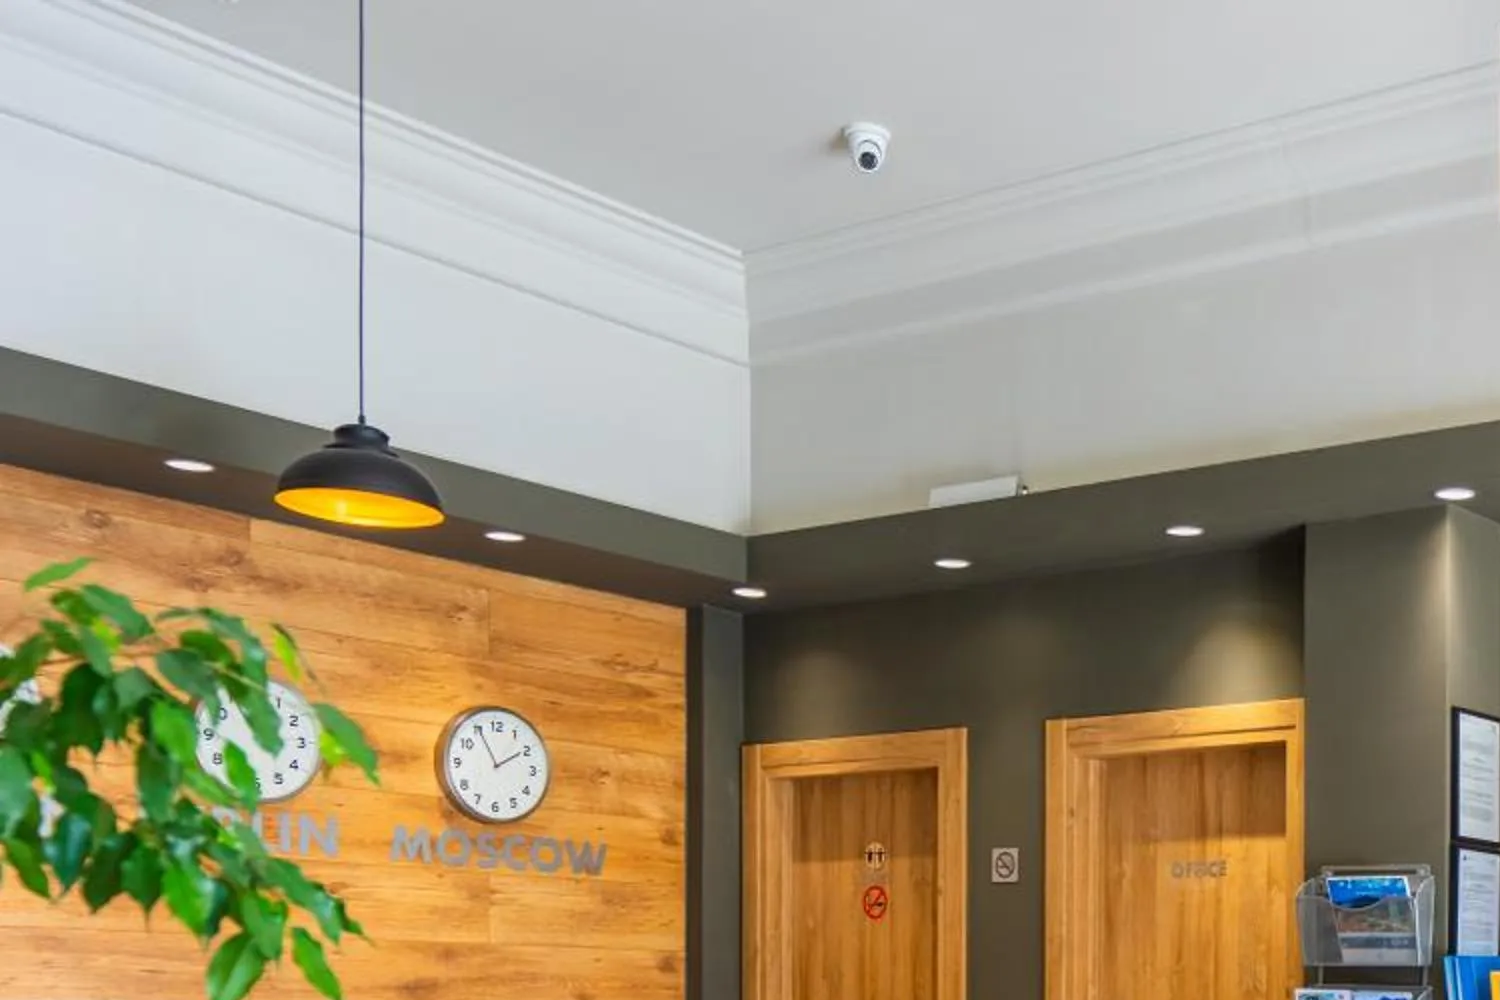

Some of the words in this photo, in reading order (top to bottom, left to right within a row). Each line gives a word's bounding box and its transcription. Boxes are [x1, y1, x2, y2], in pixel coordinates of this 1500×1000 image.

[289, 715, 299, 728] 2
[490, 719, 504, 733] 12
[203, 728, 215, 741] 9
[511, 729, 517, 740] 1
[297, 737, 306, 749] 3
[460, 737, 475, 751] 10
[523, 745, 531, 757] 2
[289, 758, 299, 770] 4
[453, 757, 462, 769] 9
[529, 765, 537, 777] 3
[273, 772, 283, 785] 5
[460, 779, 469, 791] 8
[522, 785, 531, 796] 4
[473, 793, 482, 805] 7
[509, 797, 517, 809] 5
[491, 801, 500, 813] 6
[390, 824, 608, 877] MOSCOW
